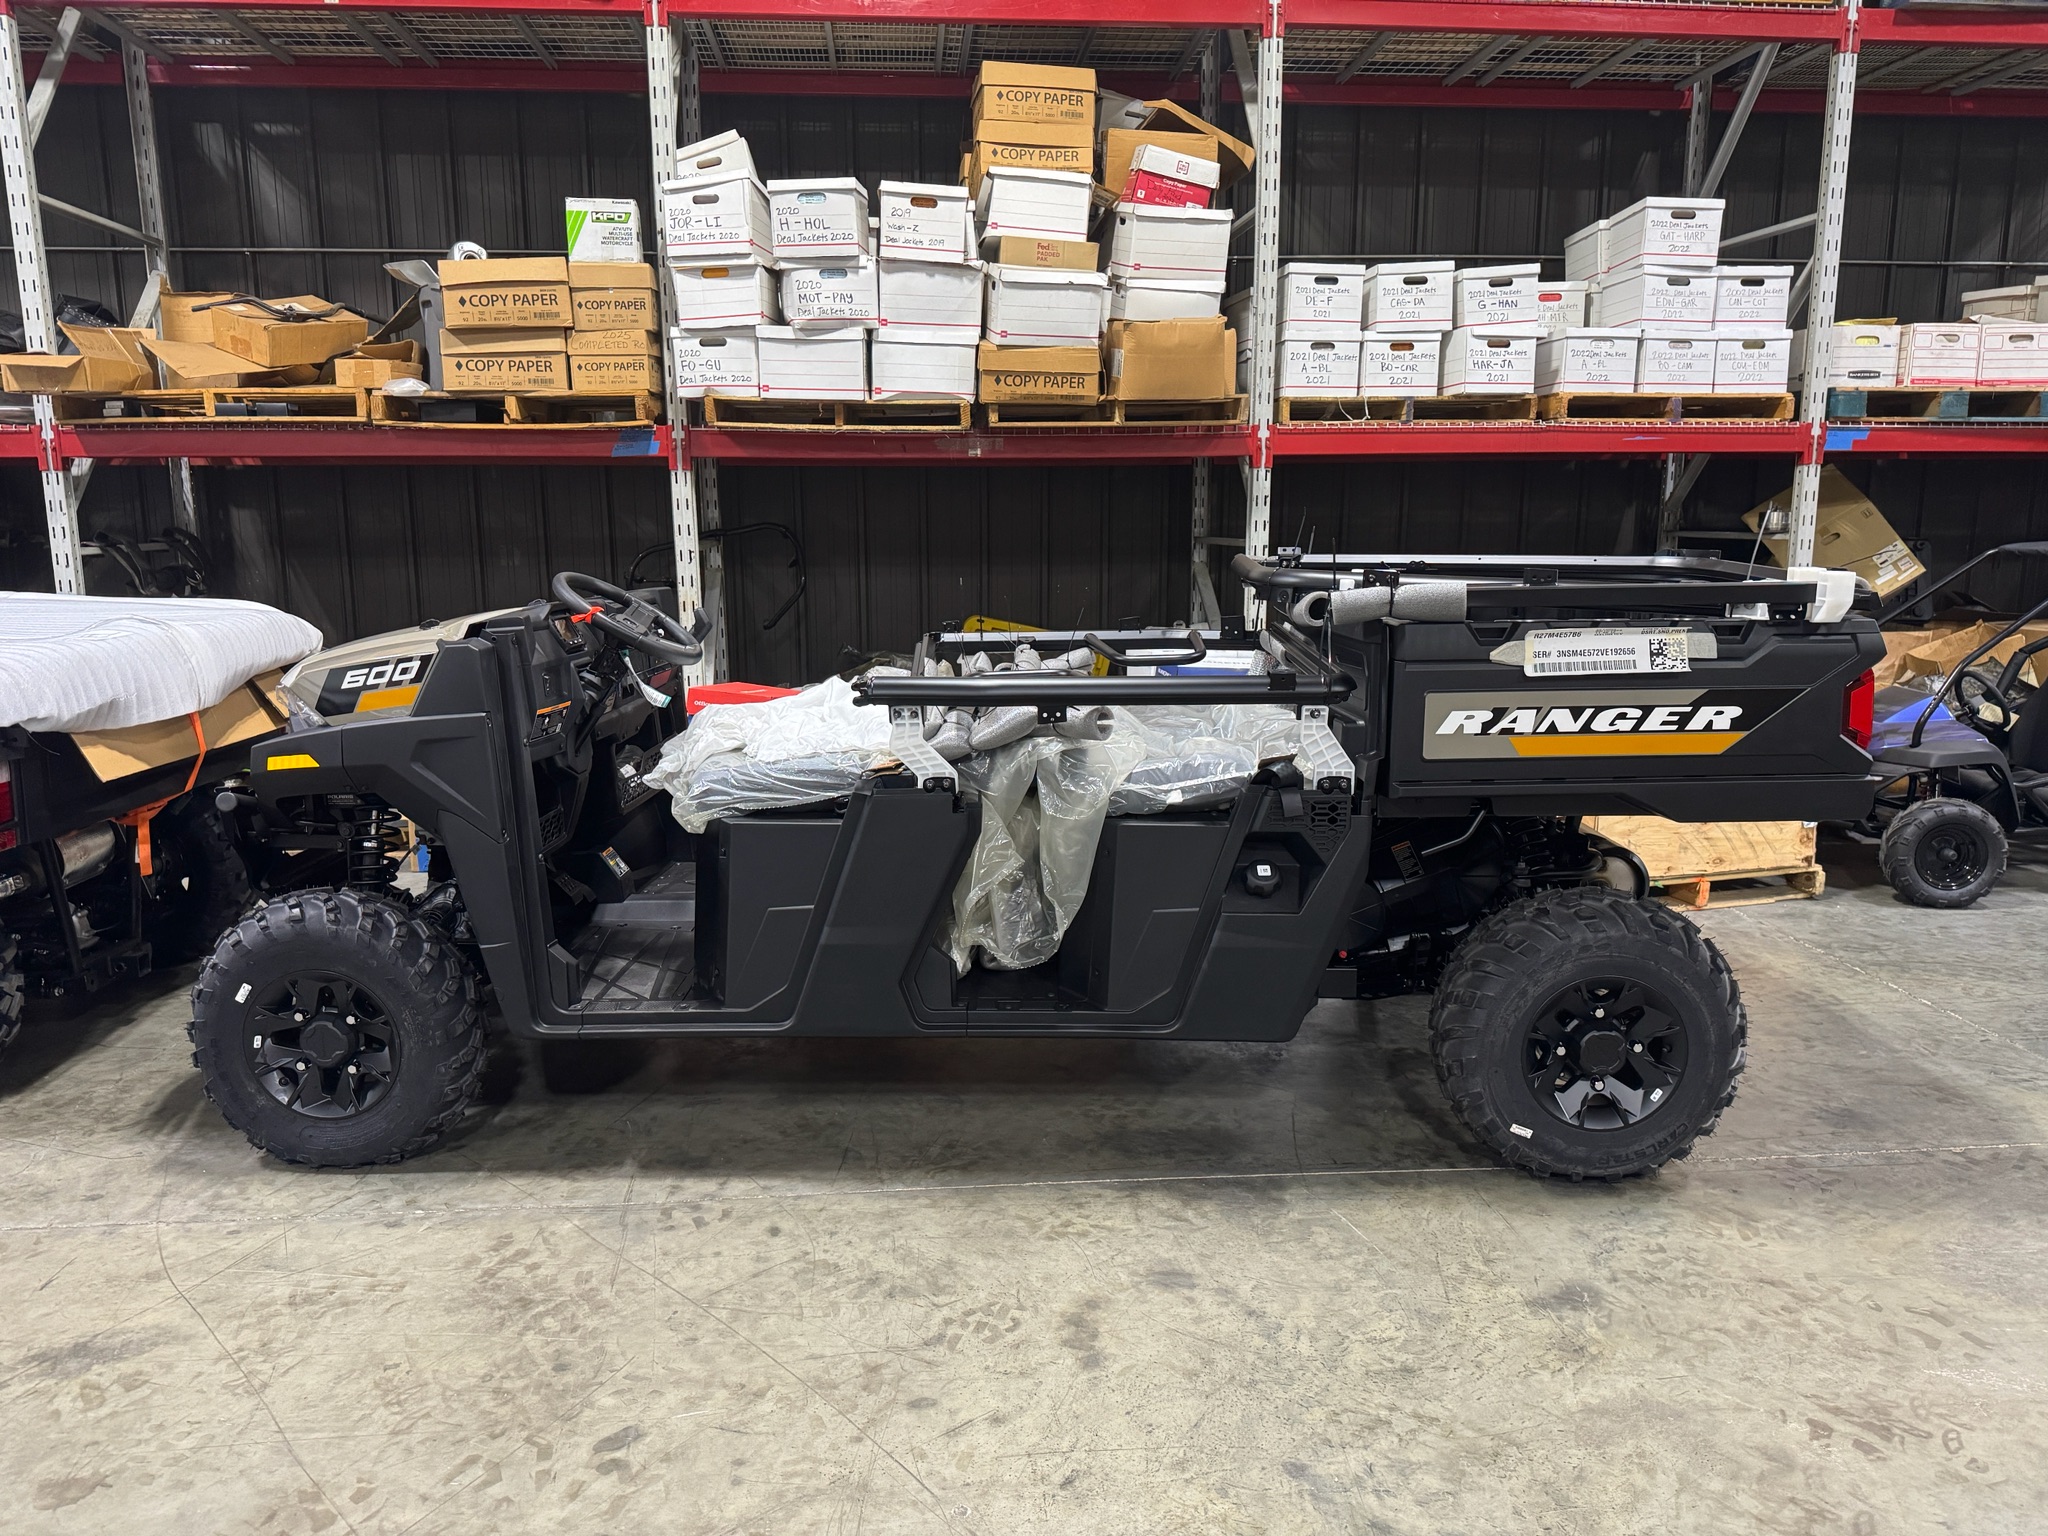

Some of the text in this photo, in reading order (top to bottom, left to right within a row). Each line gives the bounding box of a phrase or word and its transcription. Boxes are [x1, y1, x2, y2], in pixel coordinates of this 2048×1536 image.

[1006, 90, 1084, 106] COPY PAPER
[1001, 148, 1079, 162] COPY PAPER
[669, 208, 691, 217] 2020
[891, 207, 911, 217] 2019
[668, 234, 685, 243] Deal
[687, 232, 715, 241] Jackets
[777, 234, 796, 244] Deal
[798, 234, 828, 242] Jackets
[796, 280, 822, 290] 2020
[1382, 287, 1398, 296] 2021
[1468, 290, 1485, 299] 2021
[1652, 288, 1669, 296] 2022
[469, 294, 558, 307] COPY PAPER
[584, 301, 646, 310] COPY PAPER
[798, 307, 869, 317] Deal Jackets 2020
[1313, 310, 1330, 318] 2021
[1398, 311, 1420, 319] 2021
[1662, 310, 1684, 318] 2022
[1487, 312, 1508, 322] 2021
[602, 331, 634, 340] 2025
[571, 334, 628, 350] COMPLETED
[679, 350, 701, 358] 2020
[1290, 352, 1310, 360] 2021
[1313, 352, 1329, 361] Deal
[1571, 349, 1590, 357] 2022
[466, 360, 553, 372] COPY PAPER
[584, 362, 645, 371] COPY PAPER
[680, 375, 696, 385] Deal
[700, 374, 727, 383] Jackets
[1306, 376, 1330, 384] 2021
[1389, 376, 1412, 384] 2021
[1486, 373, 1509, 382] 2021
[1586, 372, 1610, 381] 2022
[1738, 373, 1763, 382] 2022
[1004, 374, 1085, 389] COPY PAPER
[1533, 647, 1636, 658] SER# 3NSM4E572VE192656
[341, 660, 421, 689] 600
[1436, 705, 1743, 735] RANGER
